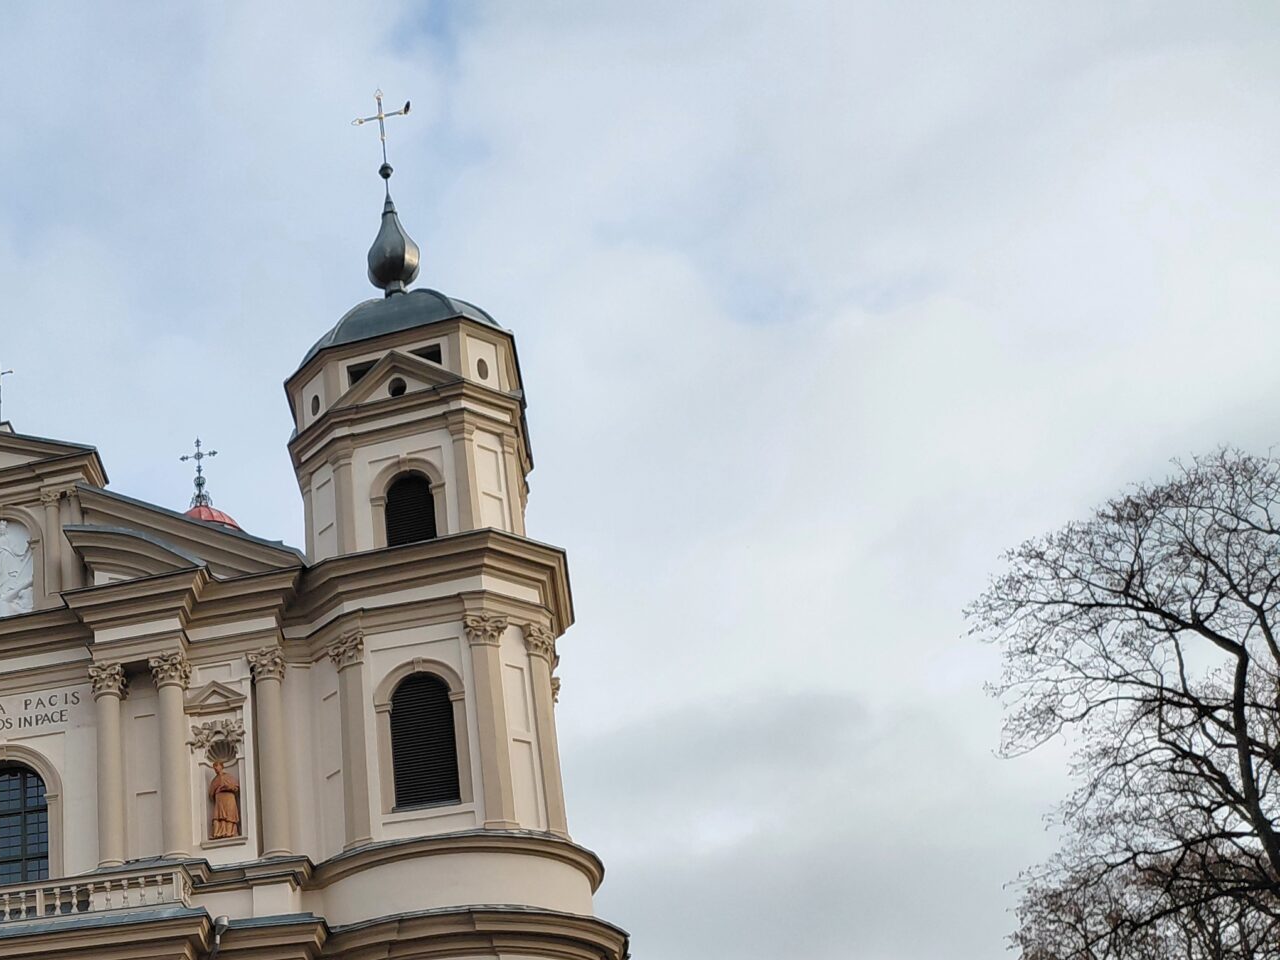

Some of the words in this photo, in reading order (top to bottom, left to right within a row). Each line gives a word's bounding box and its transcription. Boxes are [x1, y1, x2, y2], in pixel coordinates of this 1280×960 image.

[23, 691, 81, 711] PACIS
[18, 715, 33, 729] IN
[35, 709, 69, 726] PACE
